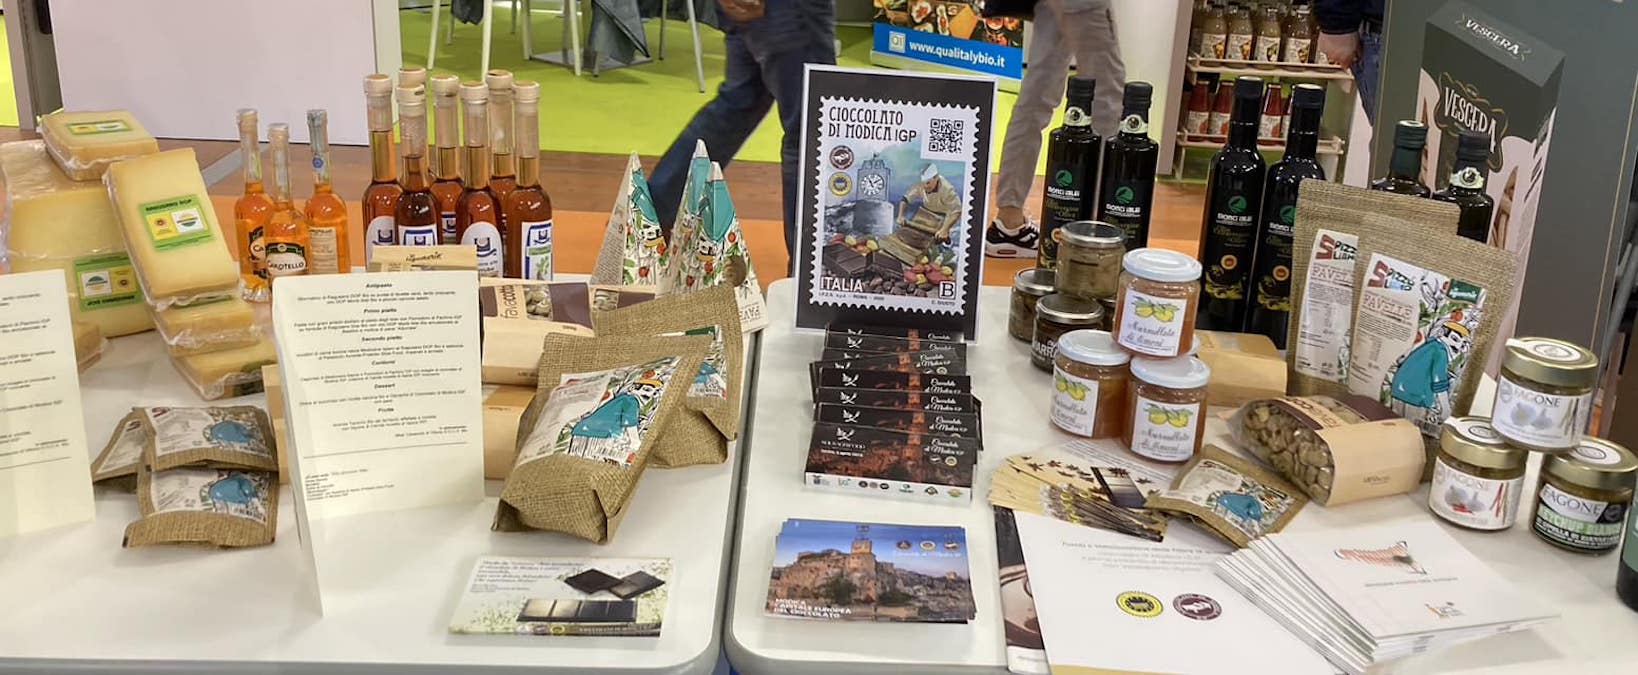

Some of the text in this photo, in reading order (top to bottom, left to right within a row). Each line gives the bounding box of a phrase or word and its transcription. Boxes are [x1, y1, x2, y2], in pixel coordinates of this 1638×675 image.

[1465, 19, 1520, 55] VESCERA
[909, 41, 1005, 67] www.qualitalybio.it
[828, 106, 904, 125] CIOCCOLATO
[828, 123, 917, 142] DI MODICA IGP
[820, 276, 863, 292] ITALIA
[941, 283, 954, 297] B
[1544, 486, 1602, 514] FAGONE
